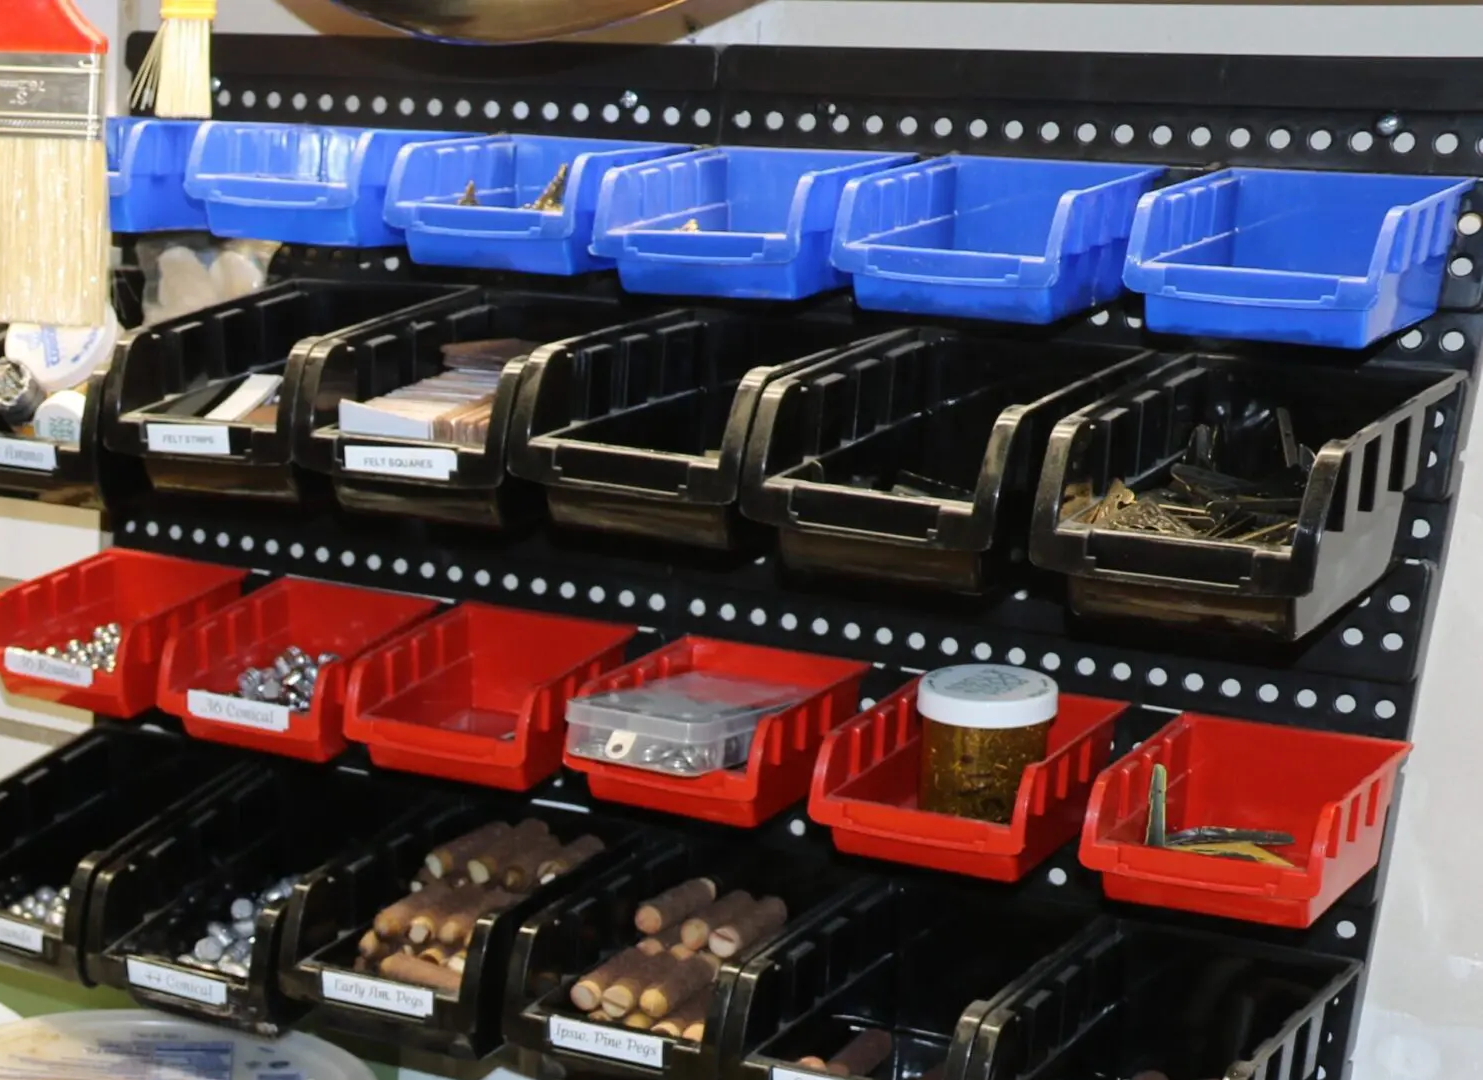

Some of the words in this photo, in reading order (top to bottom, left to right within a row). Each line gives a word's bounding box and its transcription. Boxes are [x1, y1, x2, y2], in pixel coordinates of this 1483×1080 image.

[162, 434, 183, 444] FELT
[363, 457, 387, 468] FELT
[389, 457, 433, 469] SQUARES
[226, 703, 274, 724] Conical
[165, 975, 213, 999] Conical
[332, 978, 364, 999] Early
[367, 983, 392, 1000] Am.
[395, 988, 424, 1010] Pegs
[554, 1023, 590, 1045] Ipsw.
[594, 1030, 622, 1049] Pine
[624, 1038, 658, 1059] Pegs
